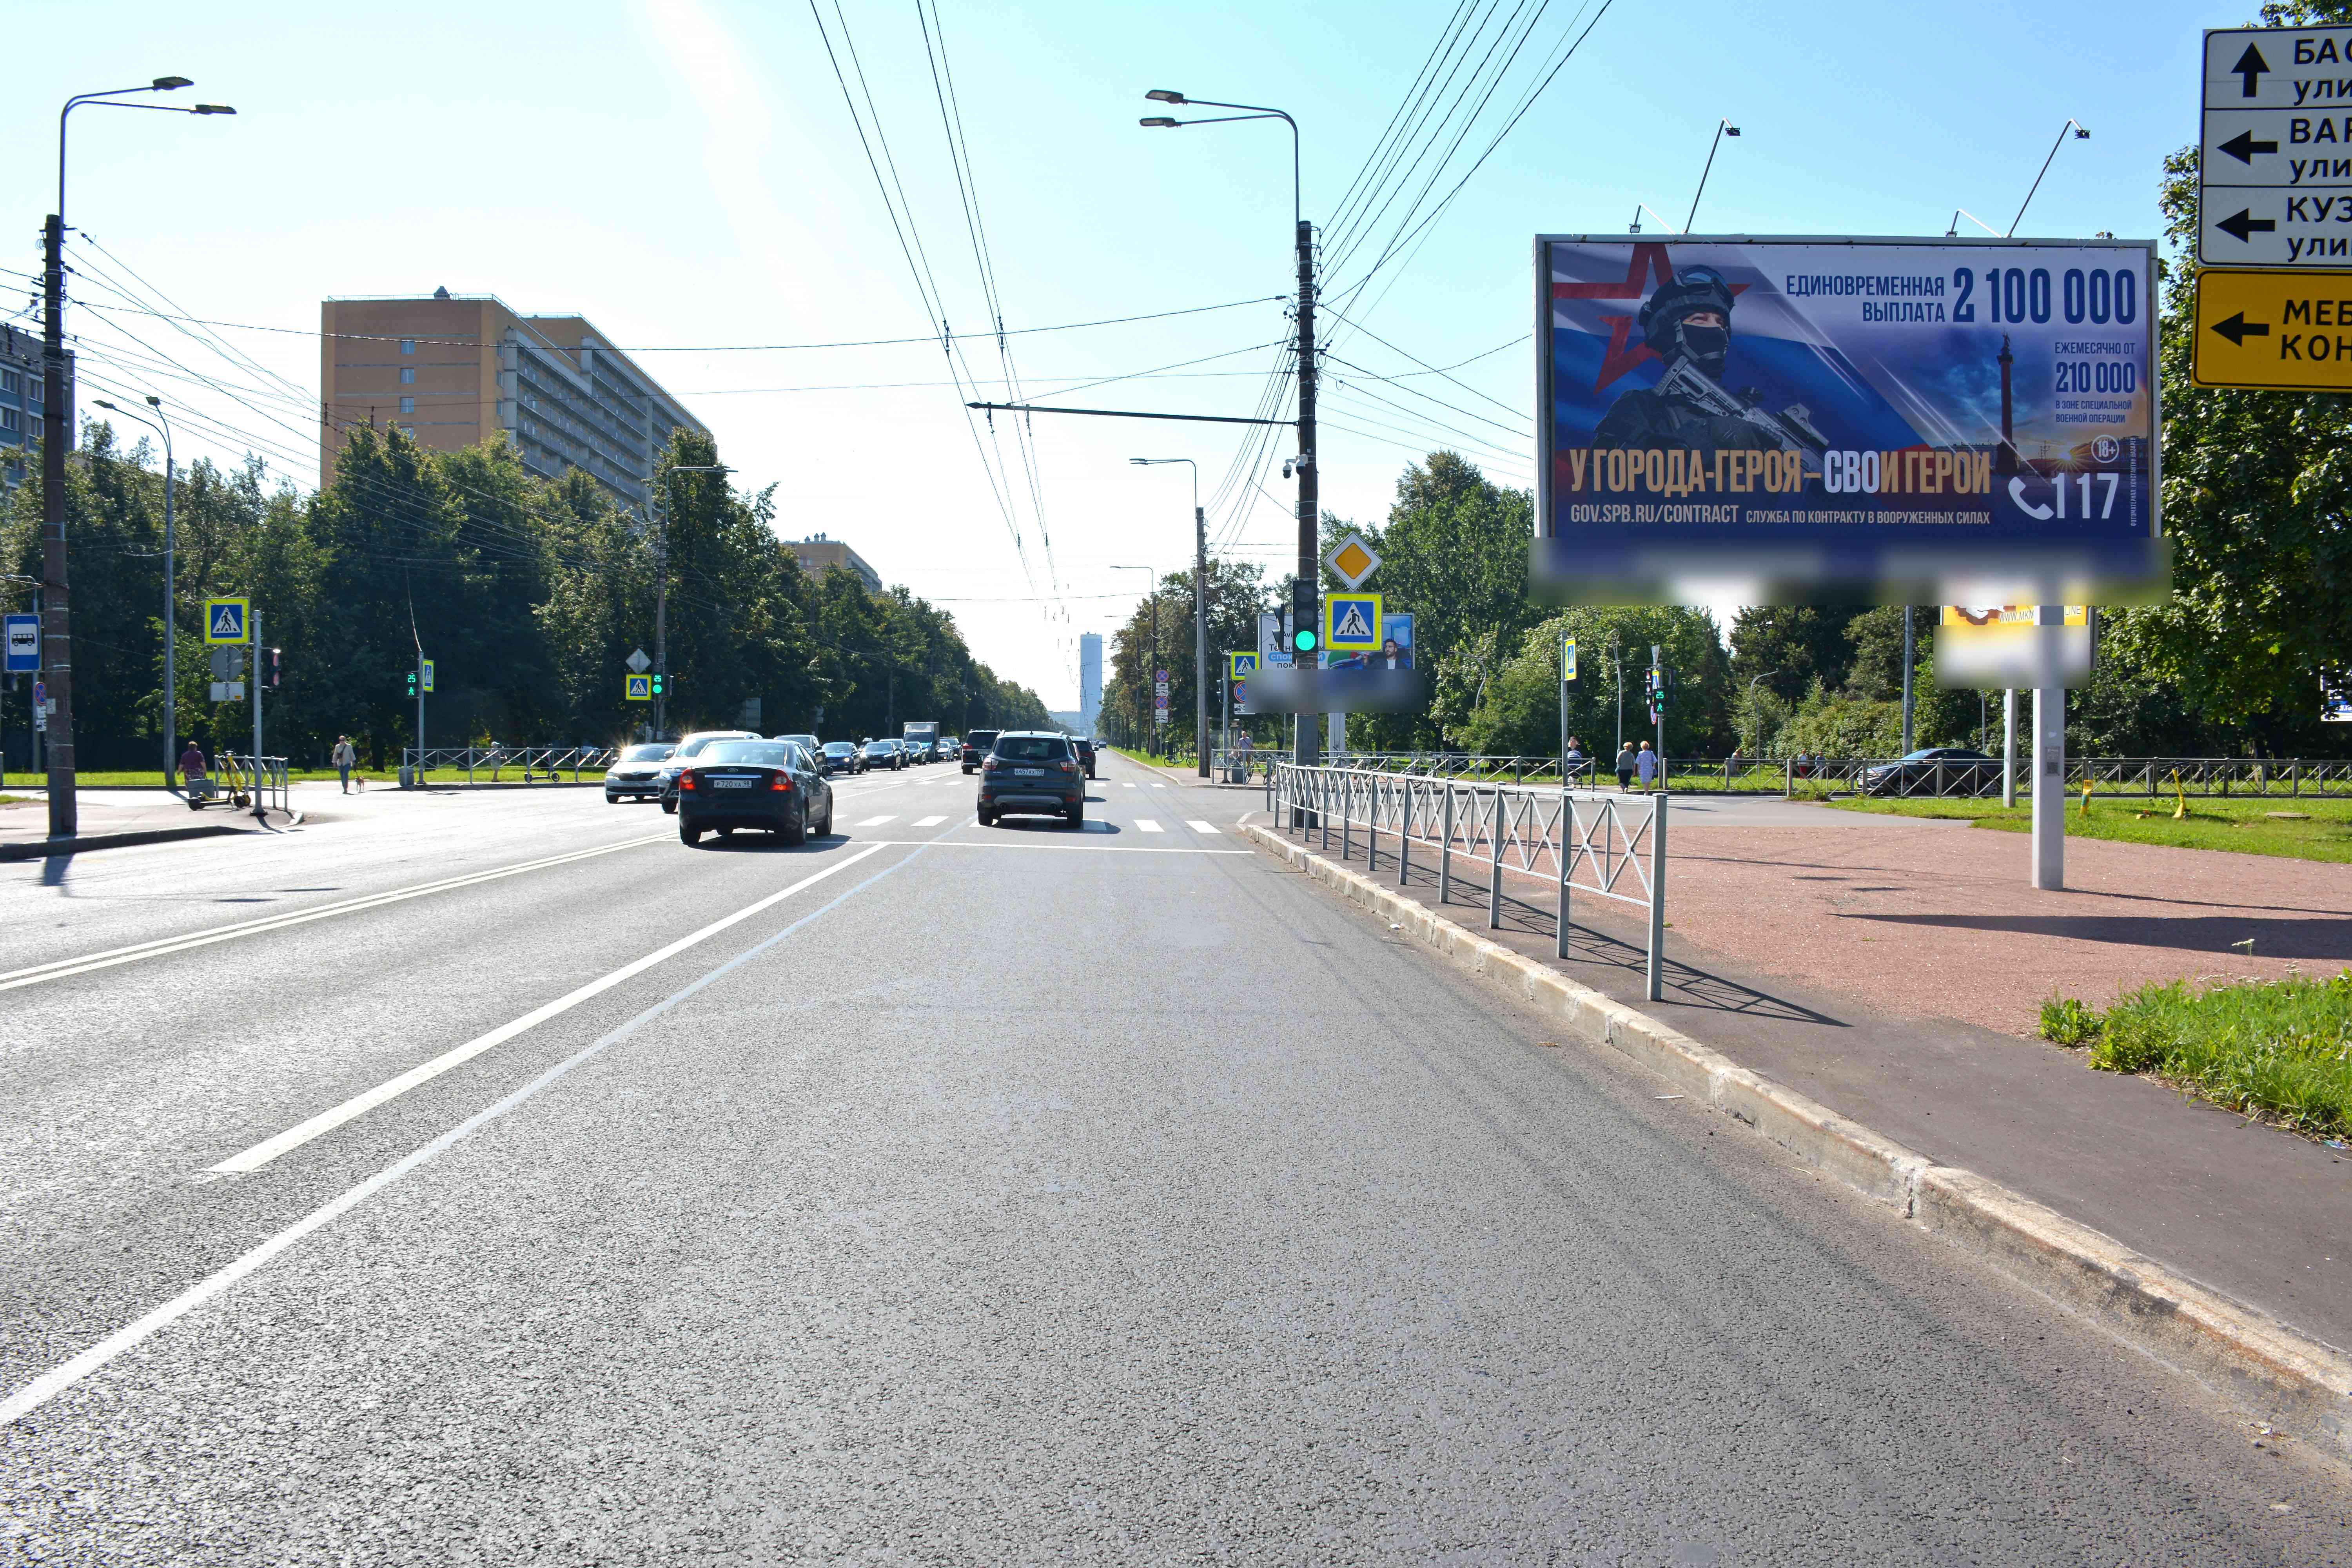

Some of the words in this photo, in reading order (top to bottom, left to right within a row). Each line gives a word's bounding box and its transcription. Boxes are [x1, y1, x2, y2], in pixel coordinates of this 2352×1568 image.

[2287, 196, 2352, 222] КУЗ
[2287, 238, 2352, 262] ули
[1786, 275, 1945, 297] ЕДИНОВРЕМЕННАЯ
[1953, 267, 1974, 322] 2
[1986, 268, 2051, 323] 100
[2064, 269, 2135, 324] 000
[1863, 302, 1945, 322] ВЫПЛАТА
[2283, 299, 2352, 326] МЕБ
[2055, 342, 2121, 354] ЕЖЕМЕСЯЧНО
[2124, 343, 2135, 354] ОТ
[2280, 334, 2352, 361] КОН
[2056, 362, 2091, 393] 210
[2096, 362, 2135, 393] 000
[2056, 401, 2060, 409] В
[2062, 401, 2079, 409] ЗОНЕ
[2081, 400, 2132, 410] СПЕЦИАЛЬНОЙ
[2056, 413, 2087, 423] ВОЕННОЙ
[2089, 414, 2125, 423] ОПЕРАЦИИ
[2097, 441, 2116, 457] 18+
[1570, 449, 1587, 491] У
[1593, 449, 1801, 497] ГОРОДА-ГЕРОЯ
[1824, 450, 1898, 493] СВОИ
[1906, 451, 1990, 494] ГЕРОИ
[2051, 473, 2119, 519] 117
[1571, 505, 1739, 523] GOV.SPB.RU/CONTRACT
[1746, 511, 1789, 523] СЛУЖБА
[1792, 511, 1805, 523] ПО
[1808, 511, 1866, 523] КОНТРАКТУ
[1868, 512, 1874, 523] В
[1877, 512, 1954, 524] ВООРУЖЕННЫХ
[1956, 512, 1990, 524] СИЛАХ
